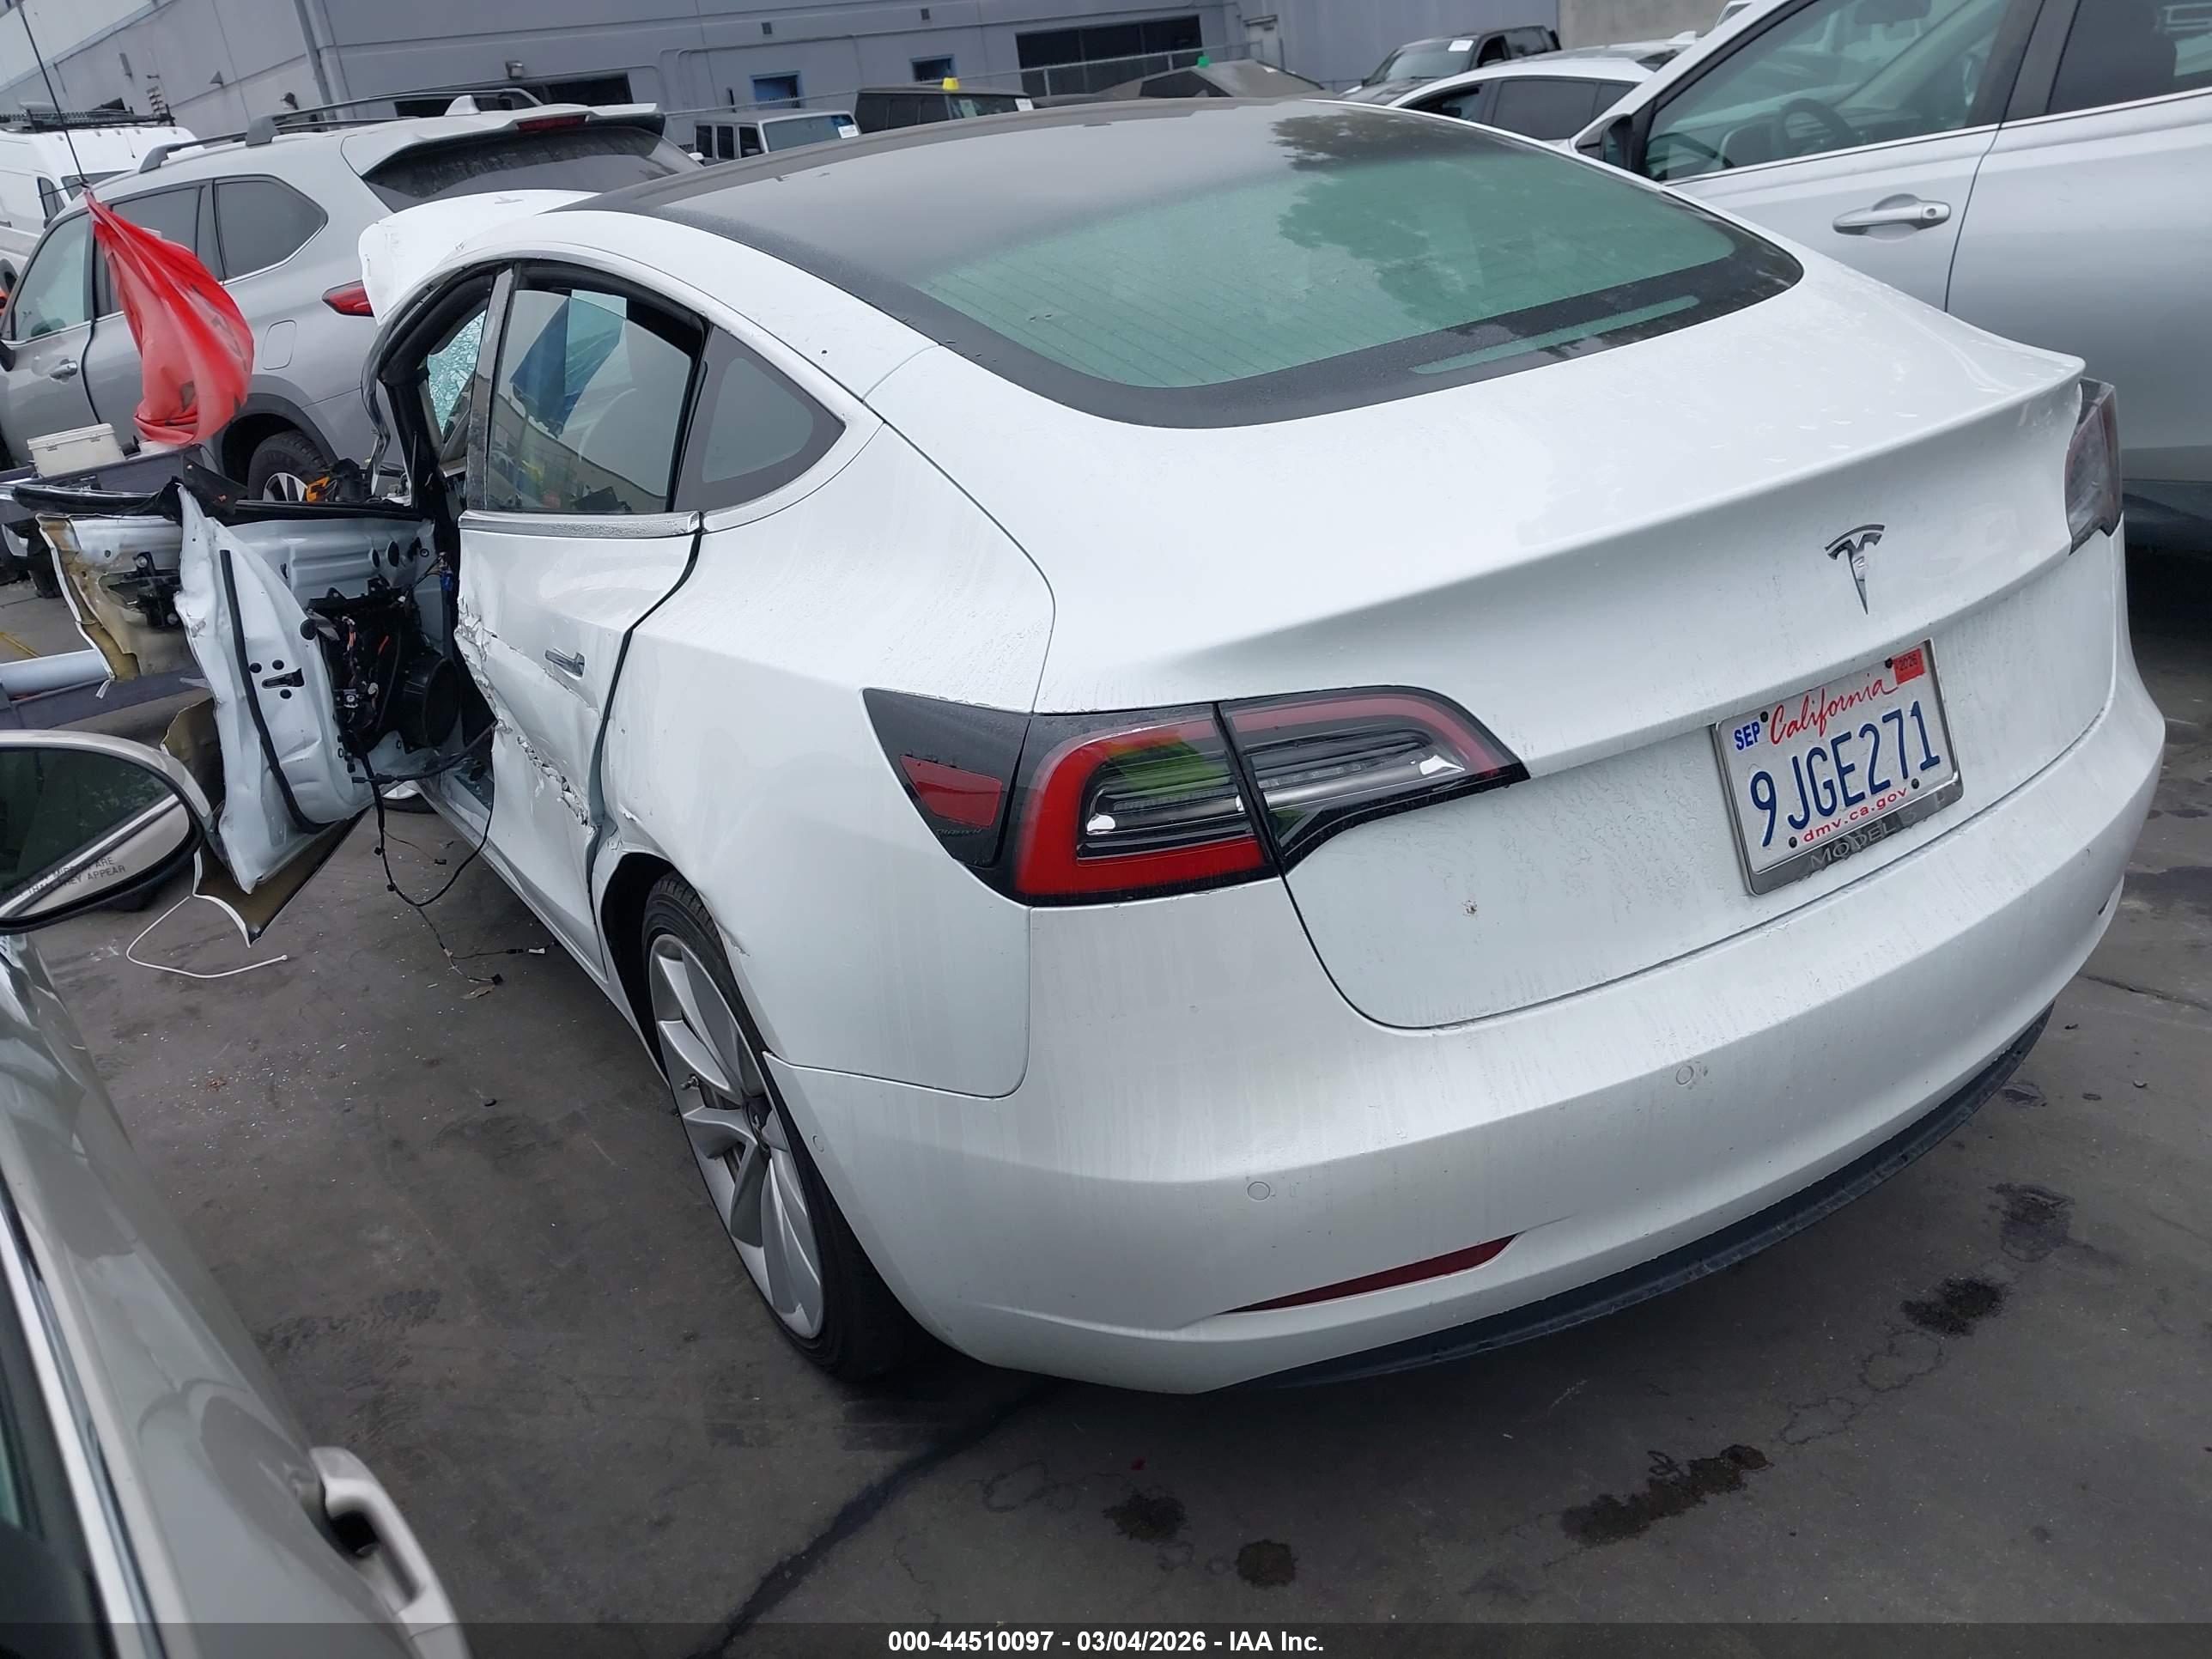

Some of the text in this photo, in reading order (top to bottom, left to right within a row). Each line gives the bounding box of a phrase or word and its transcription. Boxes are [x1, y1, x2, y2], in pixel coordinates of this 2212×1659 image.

[1770, 673, 1898, 744] California
[1734, 720, 1761, 750] SEP
[1750, 700, 1940, 848] 9JGE271
[1802, 787, 1907, 842] dmv.ca.gov
[95, 857, 114, 868] ARE
[1810, 822, 1897, 869] MODEL
[88, 865, 126, 880] APPEAR
